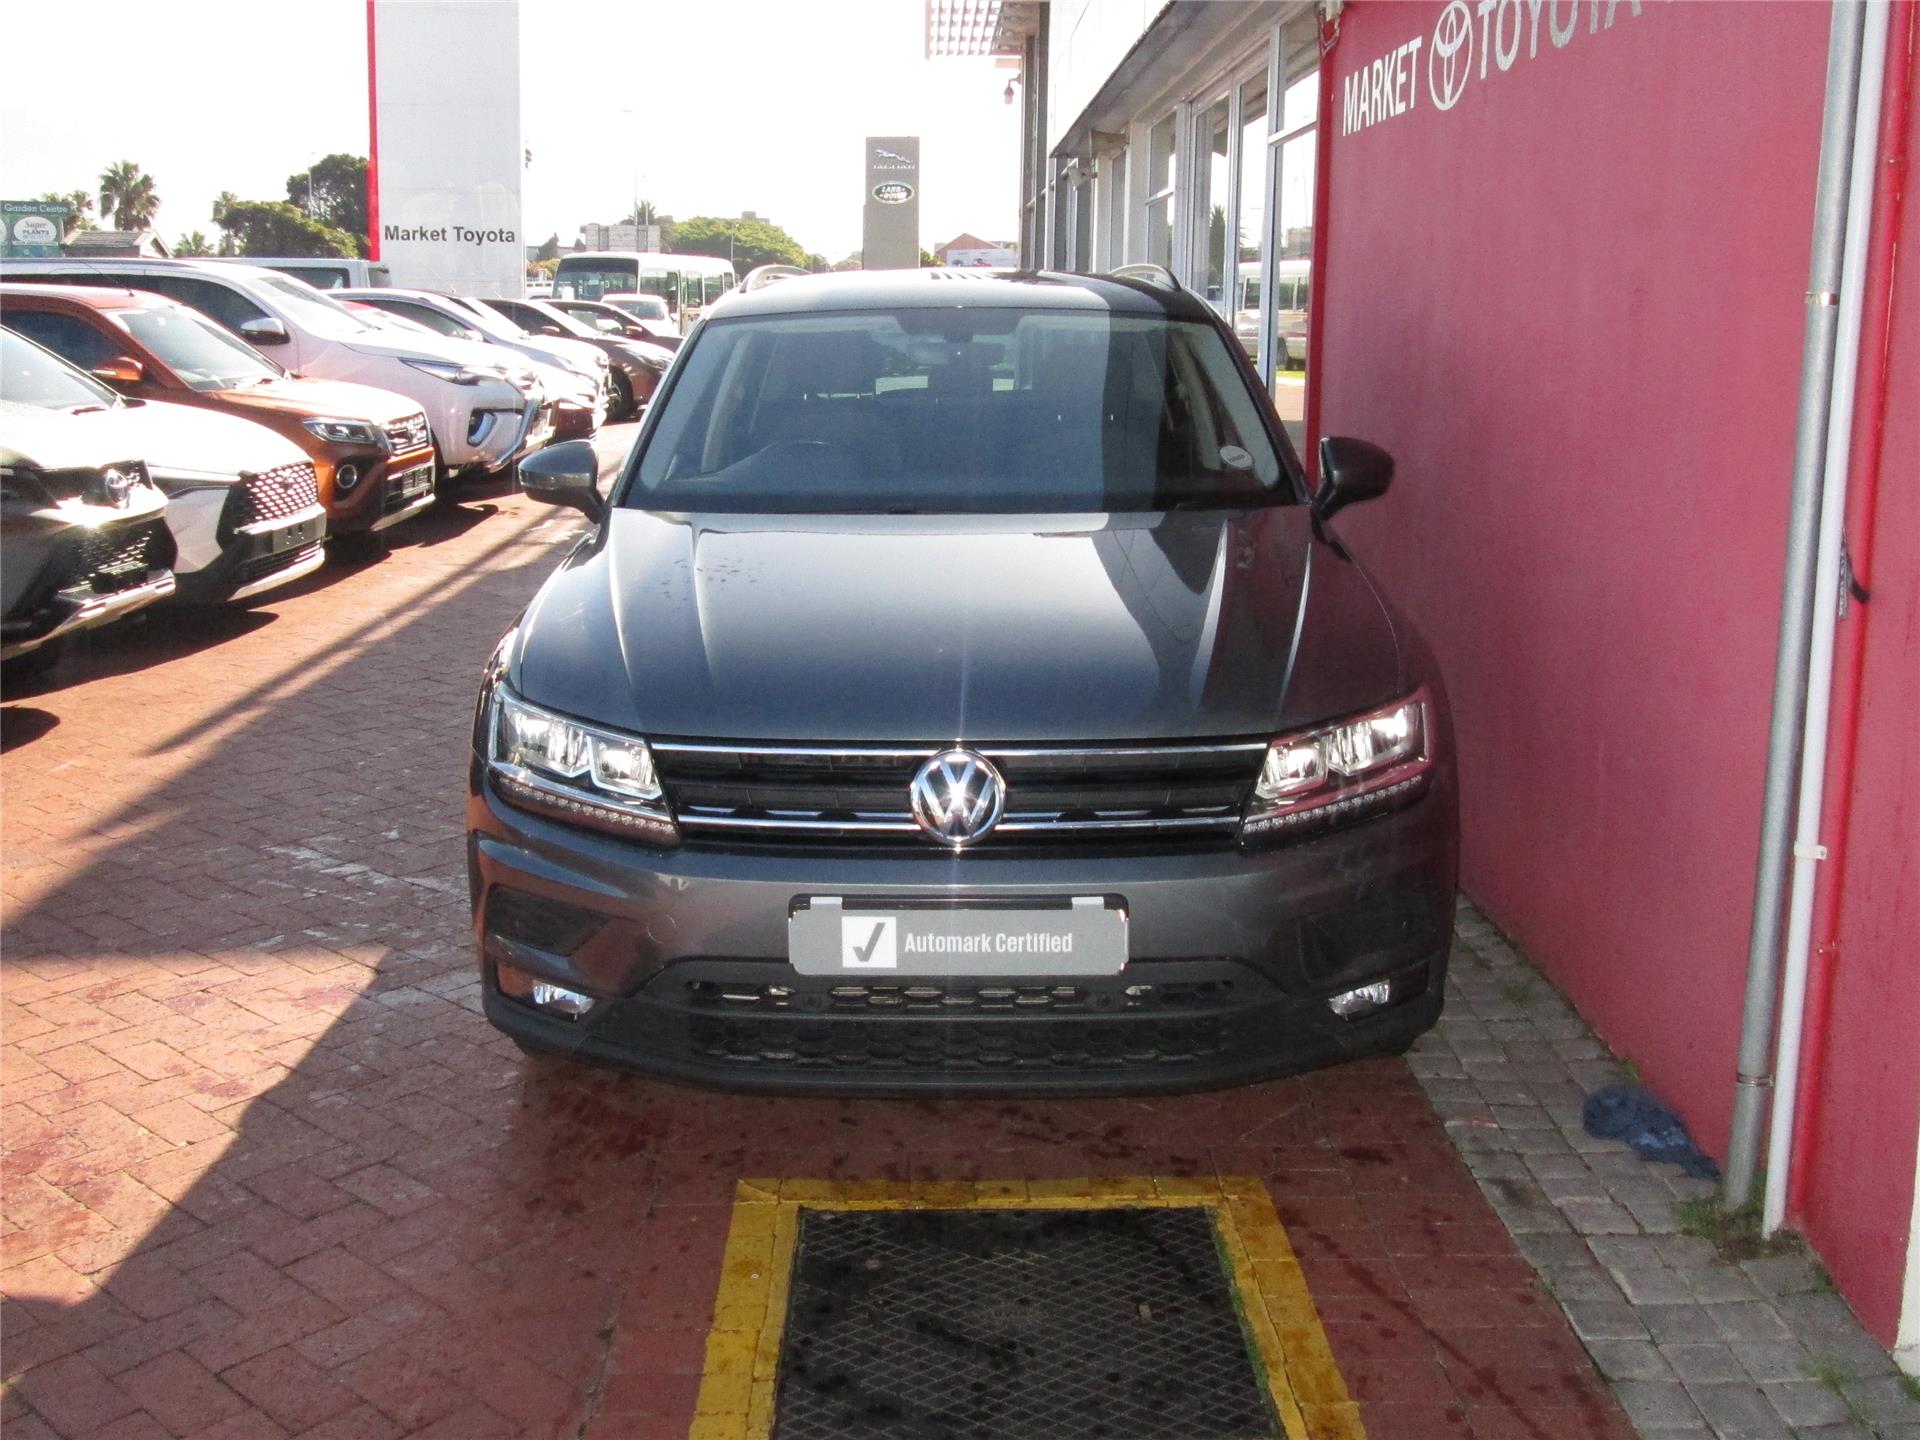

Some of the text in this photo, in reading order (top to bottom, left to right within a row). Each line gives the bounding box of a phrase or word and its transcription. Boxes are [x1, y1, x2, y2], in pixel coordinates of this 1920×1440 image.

[1343, 0, 1642, 136] MARKET TOYO
[4, 203, 68, 213] Garden Centre
[384, 225, 516, 246] Market Toyota
[904, 933, 1073, 953] Automark Certified
